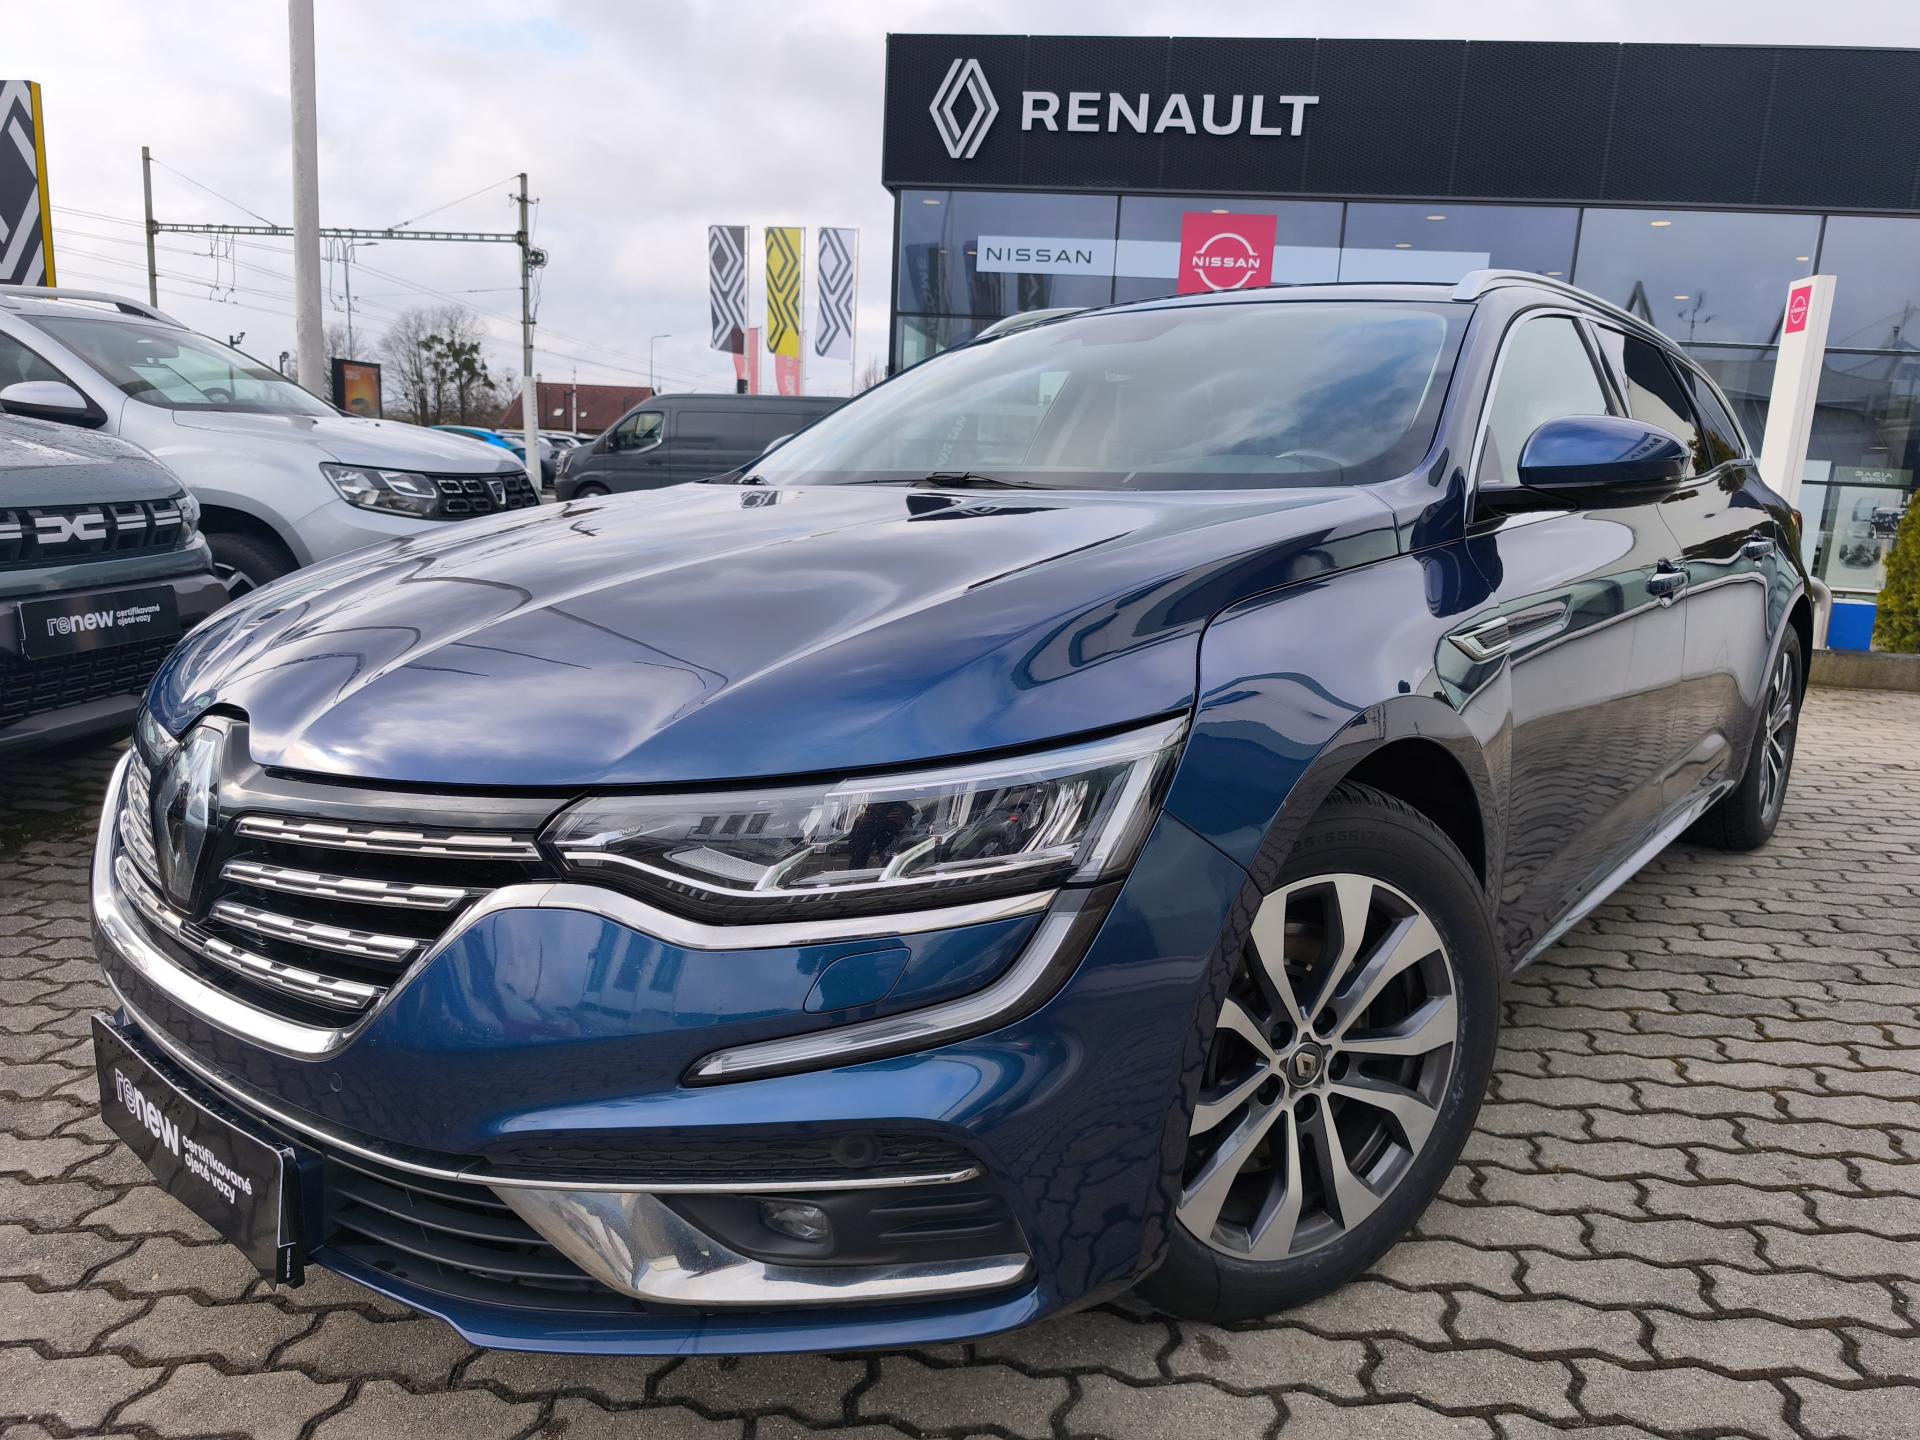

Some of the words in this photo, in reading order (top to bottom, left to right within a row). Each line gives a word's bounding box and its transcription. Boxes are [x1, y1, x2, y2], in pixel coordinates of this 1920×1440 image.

[1021, 91, 1320, 136] RENAULT
[986, 247, 1092, 264] NISSAN
[1192, 255, 1260, 269] NISSAN
[1855, 470, 1893, 478] DACIA
[116, 604, 160, 617] certifikované
[136, 614, 151, 623] vozy
[47, 610, 113, 636] renew
[114, 1067, 179, 1157] renew
[182, 1135, 252, 1196] certifikované
[184, 1153, 210, 1182] ojeté
[210, 1172, 235, 1204] vozy
